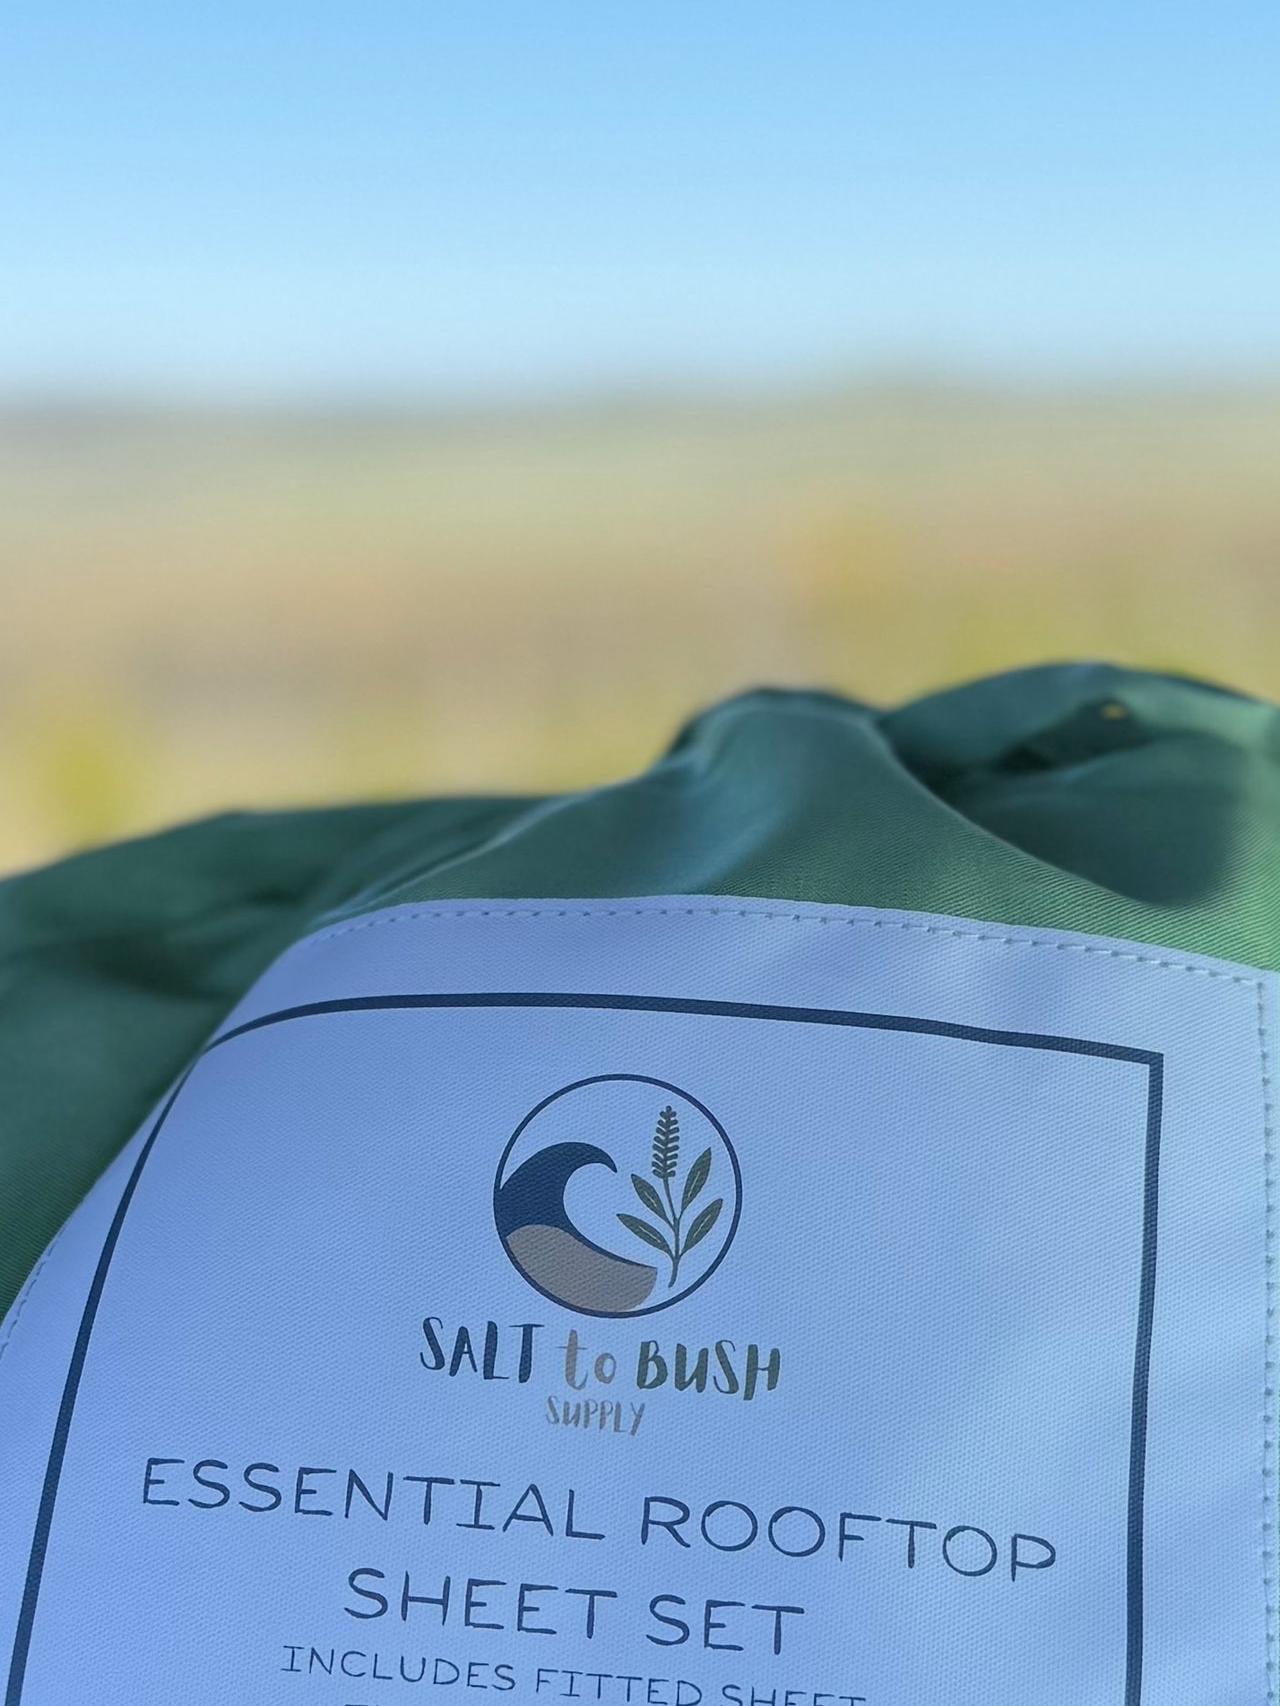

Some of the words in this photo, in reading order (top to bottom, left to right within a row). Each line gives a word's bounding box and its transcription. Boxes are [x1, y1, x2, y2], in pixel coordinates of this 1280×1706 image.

[420, 1317, 545, 1384] SALT
[558, 1329, 617, 1390] to
[636, 1339, 781, 1401] BUSH
[546, 1395, 646, 1436] SUPPLY
[142, 1457, 606, 1540] ESSENTIAL
[641, 1496, 1056, 1582] ROOFTOP
[343, 1567, 618, 1639] SHEET
[646, 1594, 805, 1655] SET
[281, 1645, 516, 1691] INCLUDES
